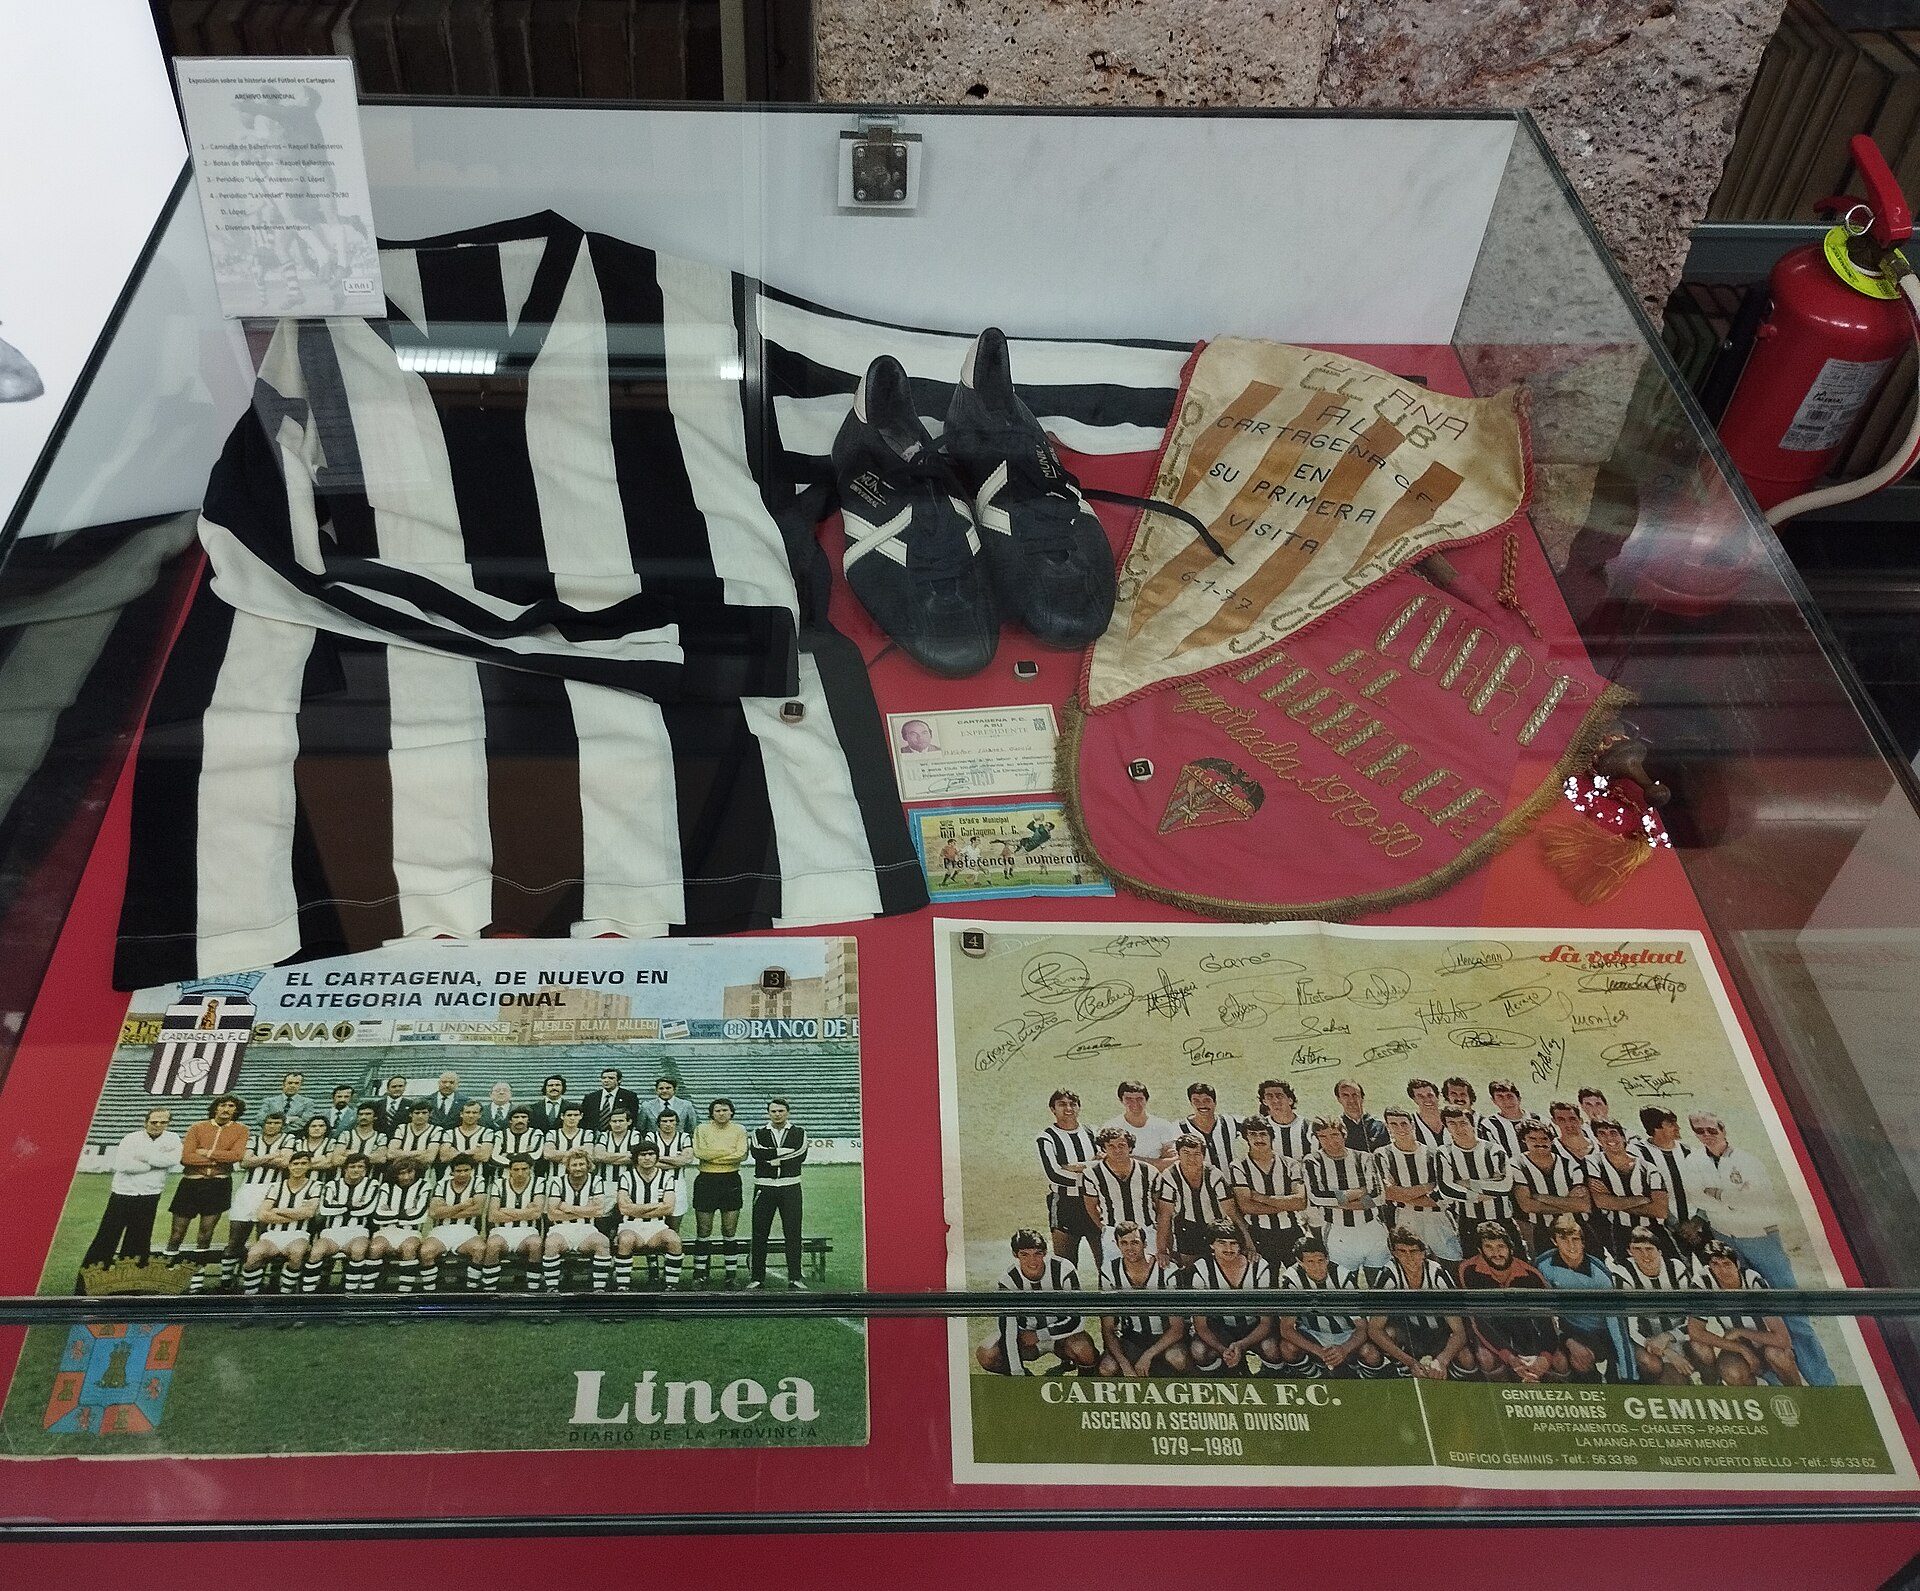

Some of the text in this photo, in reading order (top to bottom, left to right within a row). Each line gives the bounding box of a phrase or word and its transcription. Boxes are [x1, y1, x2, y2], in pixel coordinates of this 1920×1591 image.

[188, 77, 219, 85] Exposición
[220, 77, 237, 85] sobre
[244, 77, 267, 85] historia
[267, 77, 277, 85] del
[305, 77, 336, 85] Cartagena
[1299, 367, 1437, 450] CLUB
[1316, 404, 1371, 444] AL
[1216, 415, 1387, 470] CARTAGENA
[1293, 463, 1332, 484] EN
[1209, 462, 1377, 525] SU PRIMERA
[1229, 514, 1321, 555] VISITA
[957, 717, 1008, 725] CARTAGENA
[960, 727, 1027, 737] EXPRESIDENTE
[1135, 763, 1146, 775] 5
[982, 816, 1010, 824] Municipal
[960, 826, 996, 838] Cartagena
[943, 854, 1015, 869] Preferencia
[968, 935, 979, 947] 4
[1539, 944, 1582, 964] La
[286, 969, 669, 987] EL CARTAGENA, DE NUEVO EN
[769, 973, 780, 985] 3
[280, 991, 566, 1008] CATEGORIA NACIONAL
[252, 1022, 326, 1042] SAVA
[418, 1022, 434, 1032] LA
[440, 1022, 509, 1033] UNIONENSE
[533, 1019, 659, 1031] MUEBLES BLAYA GALLEGO
[750, 1019, 818, 1039] BANCO
[823, 1018, 847, 1039] DE
[161, 1031, 225, 1041] CARTAGENA
[1040, 1381, 1342, 1408] CARTAGENA F.C.
[1501, 1389, 1607, 1402] GENTILEZA DE:
[1505, 1404, 1608, 1420] PROMOCIONES
[1623, 1396, 1765, 1422] GEMINIS
[1080, 1411, 1310, 1432] ASCENSO A SEGUNDA DIVISION
[1533, 1422, 1629, 1434] APARTAMENTOS
[1641, 1424, 1693, 1435] CHALETS
[1708, 1424, 1769, 1436] PARCELAS
[568, 1426, 819, 1443] DIARIO DE LA PROVINCIA
[1575, 1437, 1738, 1449] LA MANGA DEL MAR MENOR
[1449, 1451, 1500, 1464] EDIFICIO
[1502, 1453, 1554, 1465] GEMINIS
[1659, 1455, 1701, 1467] NUEVO
[1703, 1456, 1750, 1467] PUERTO
[1754, 1457, 1792, 1468] BELLO
